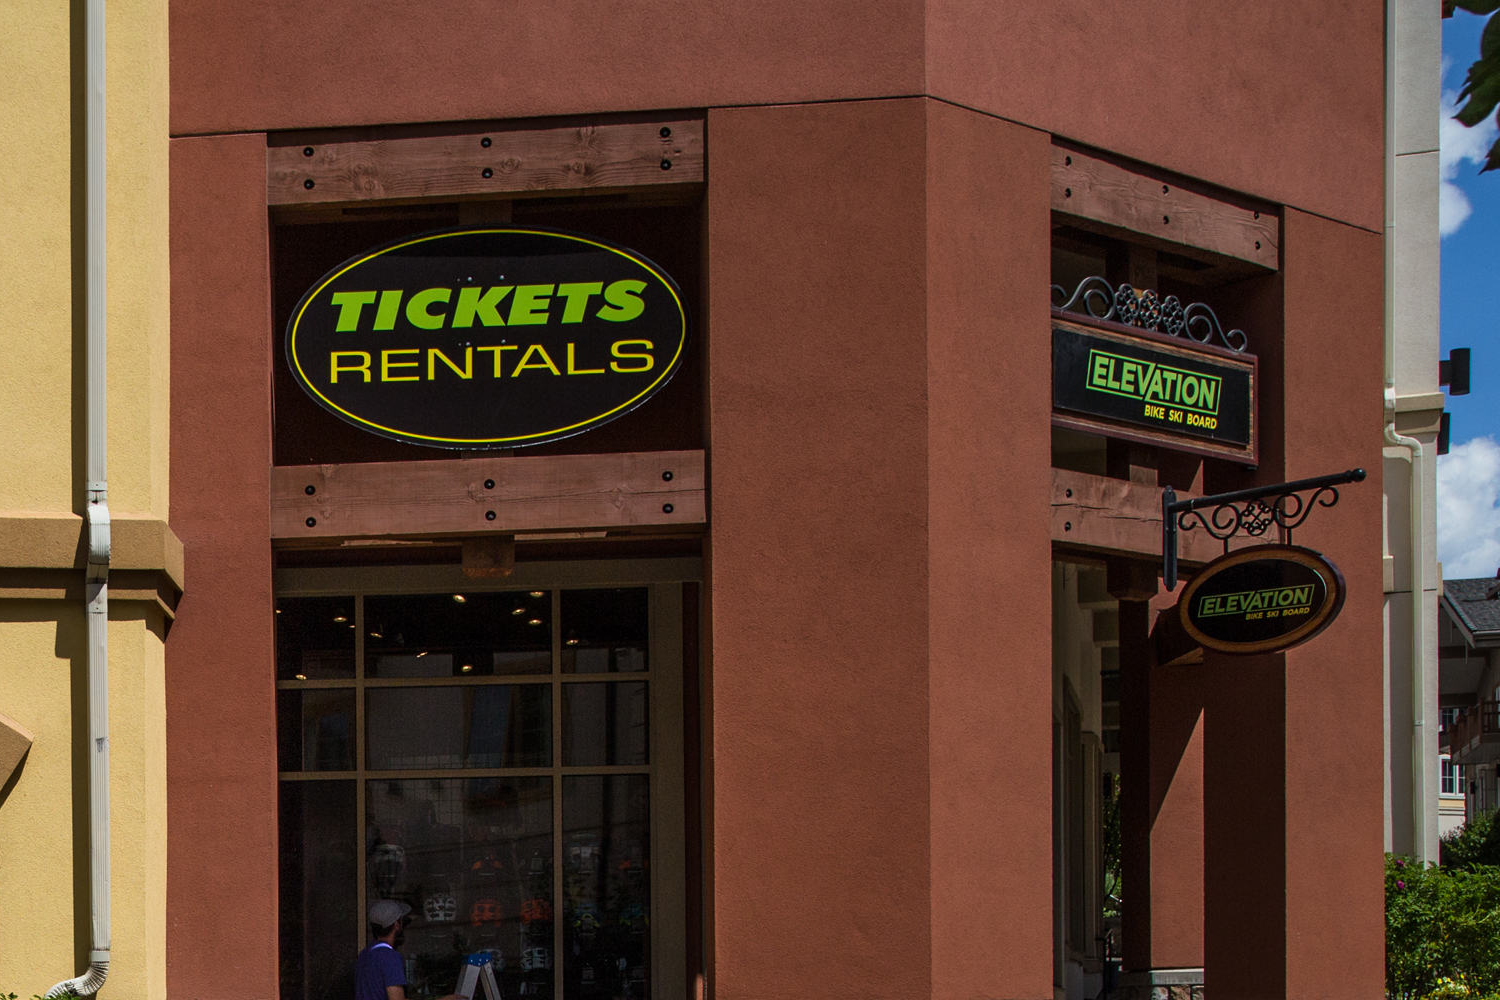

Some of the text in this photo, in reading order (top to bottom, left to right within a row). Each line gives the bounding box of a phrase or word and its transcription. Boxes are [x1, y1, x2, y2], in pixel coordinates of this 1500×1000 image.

[331, 279, 648, 332] TICKETS
[330, 339, 654, 383] RENTALS
[1092, 355, 1217, 409] ELEVATION
[1144, 404, 1217, 429] BIKE SKI BOARD
[1203, 586, 1310, 614] ELEVATION
[1245, 607, 1310, 620] BIKE SKI BOARD
